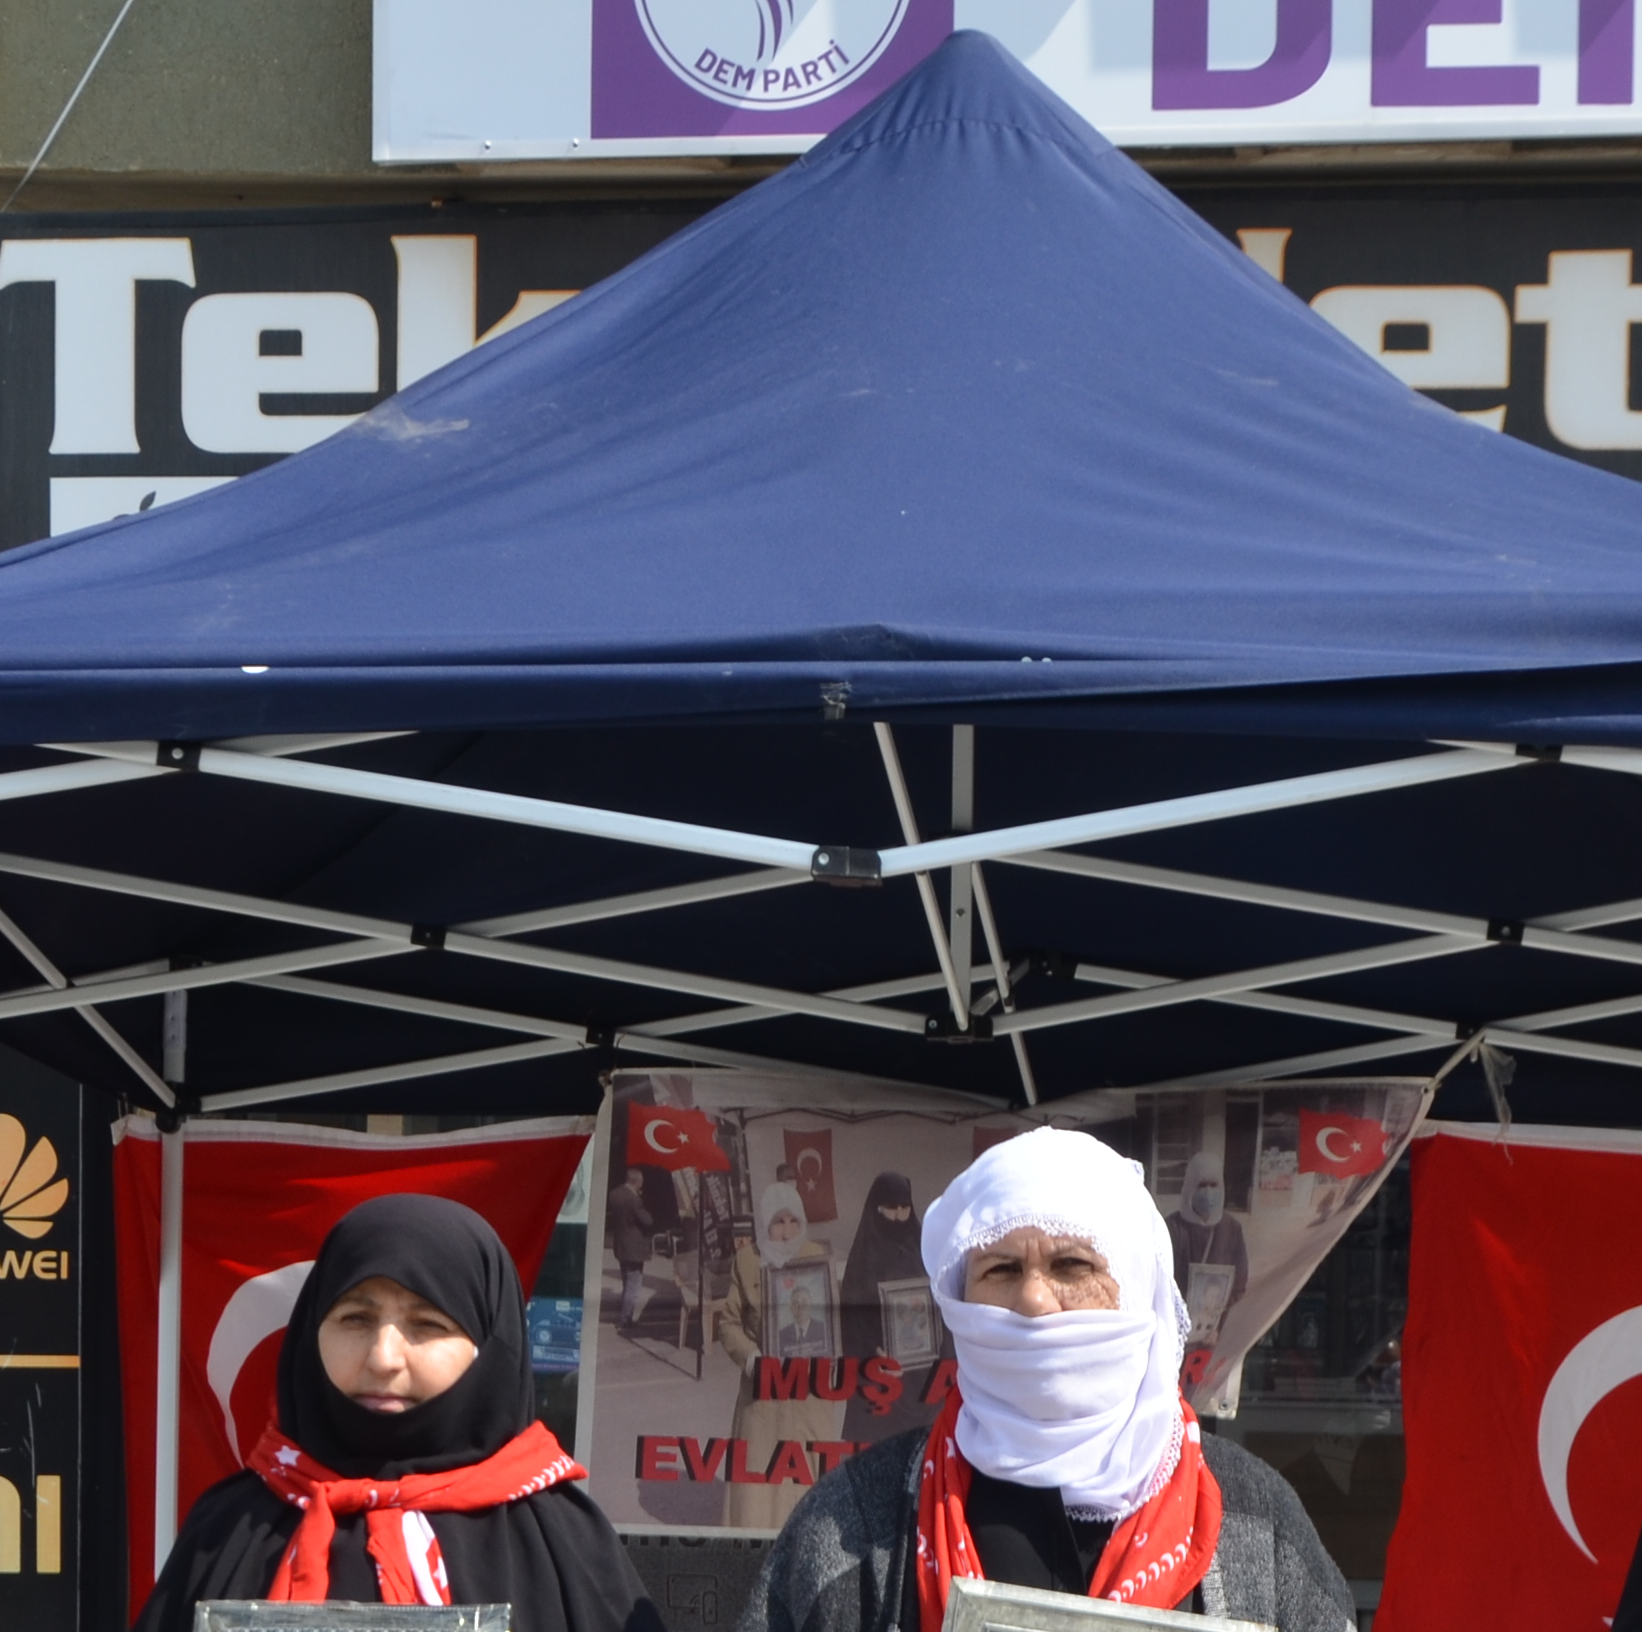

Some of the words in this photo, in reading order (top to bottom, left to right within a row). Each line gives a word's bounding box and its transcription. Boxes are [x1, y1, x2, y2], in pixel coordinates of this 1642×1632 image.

[694, 48, 756, 92] DEM
[763, 39, 850, 93] PARTİ
[757, 1356, 904, 1415] MUŞ
